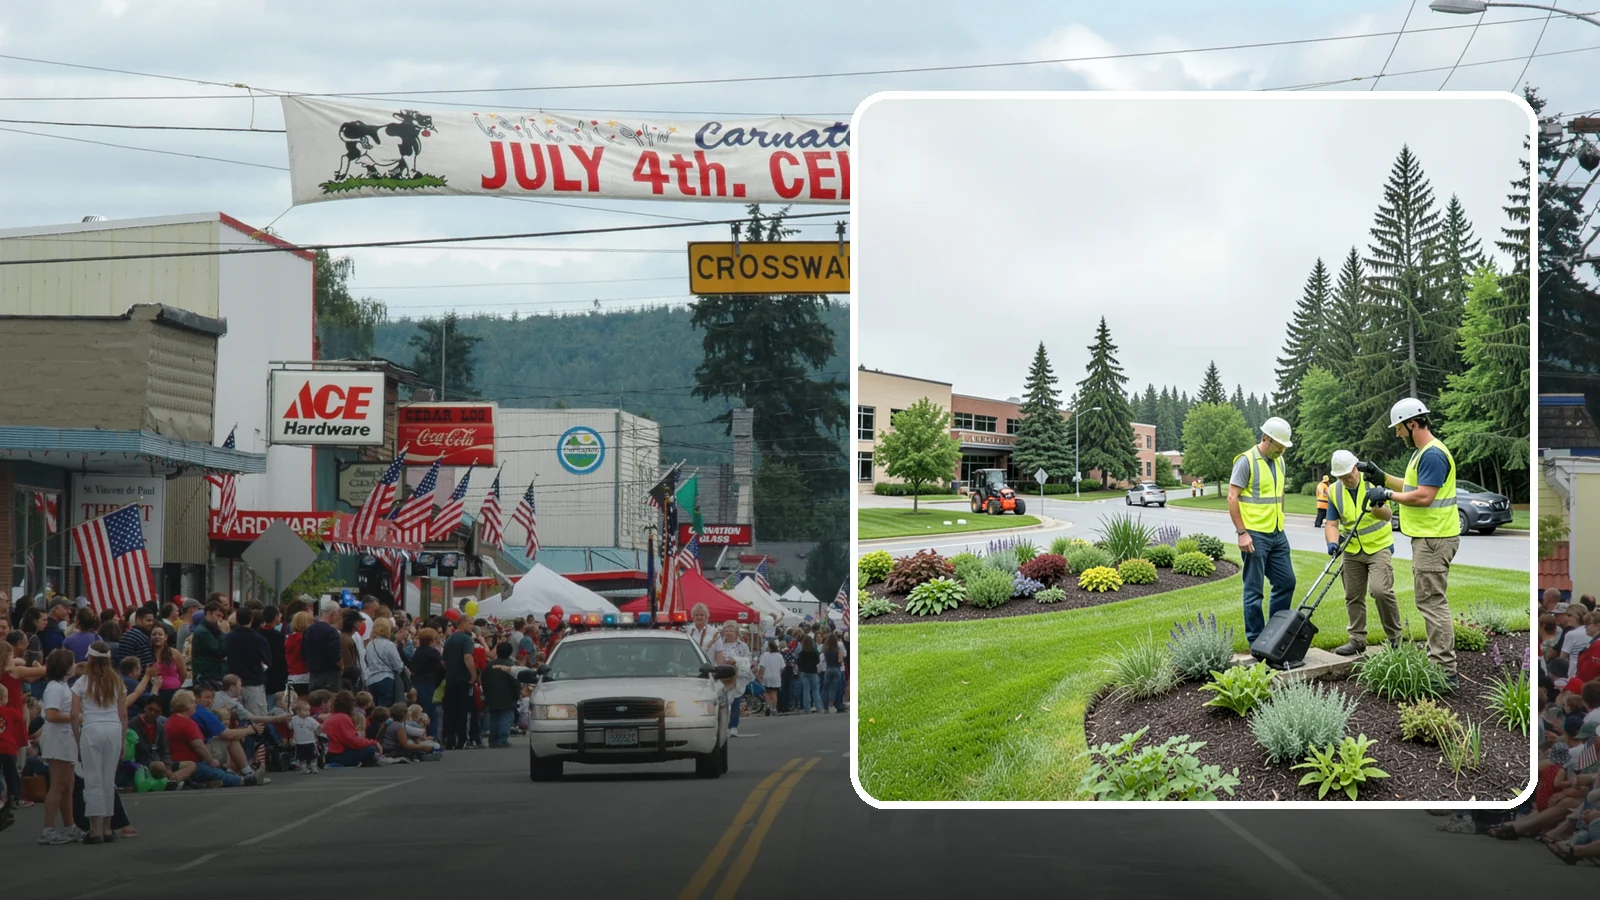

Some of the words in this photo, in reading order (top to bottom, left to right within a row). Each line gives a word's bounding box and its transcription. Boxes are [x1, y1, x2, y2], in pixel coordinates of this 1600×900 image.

[481, 141, 605, 193] JULY
[632, 150, 747, 198] 4th.
[697, 254, 850, 280] CROSSWA
[283, 380, 373, 420] ACE
[406, 409, 453, 422] CEDAR
[283, 421, 370, 436] Hardware
[416, 428, 477, 446] Coca-Cola
[353, 467, 385, 479] Simpl
[82, 485, 94, 495] St.
[96, 485, 124, 495] Vincent
[126, 486, 136, 495] de
[137, 485, 155, 495] Paul
[81, 503, 154, 522] THRT
[212, 516, 331, 535] HARDARE
[688, 526, 741, 535] CRNATION
[699, 535, 730, 544] GLASS
